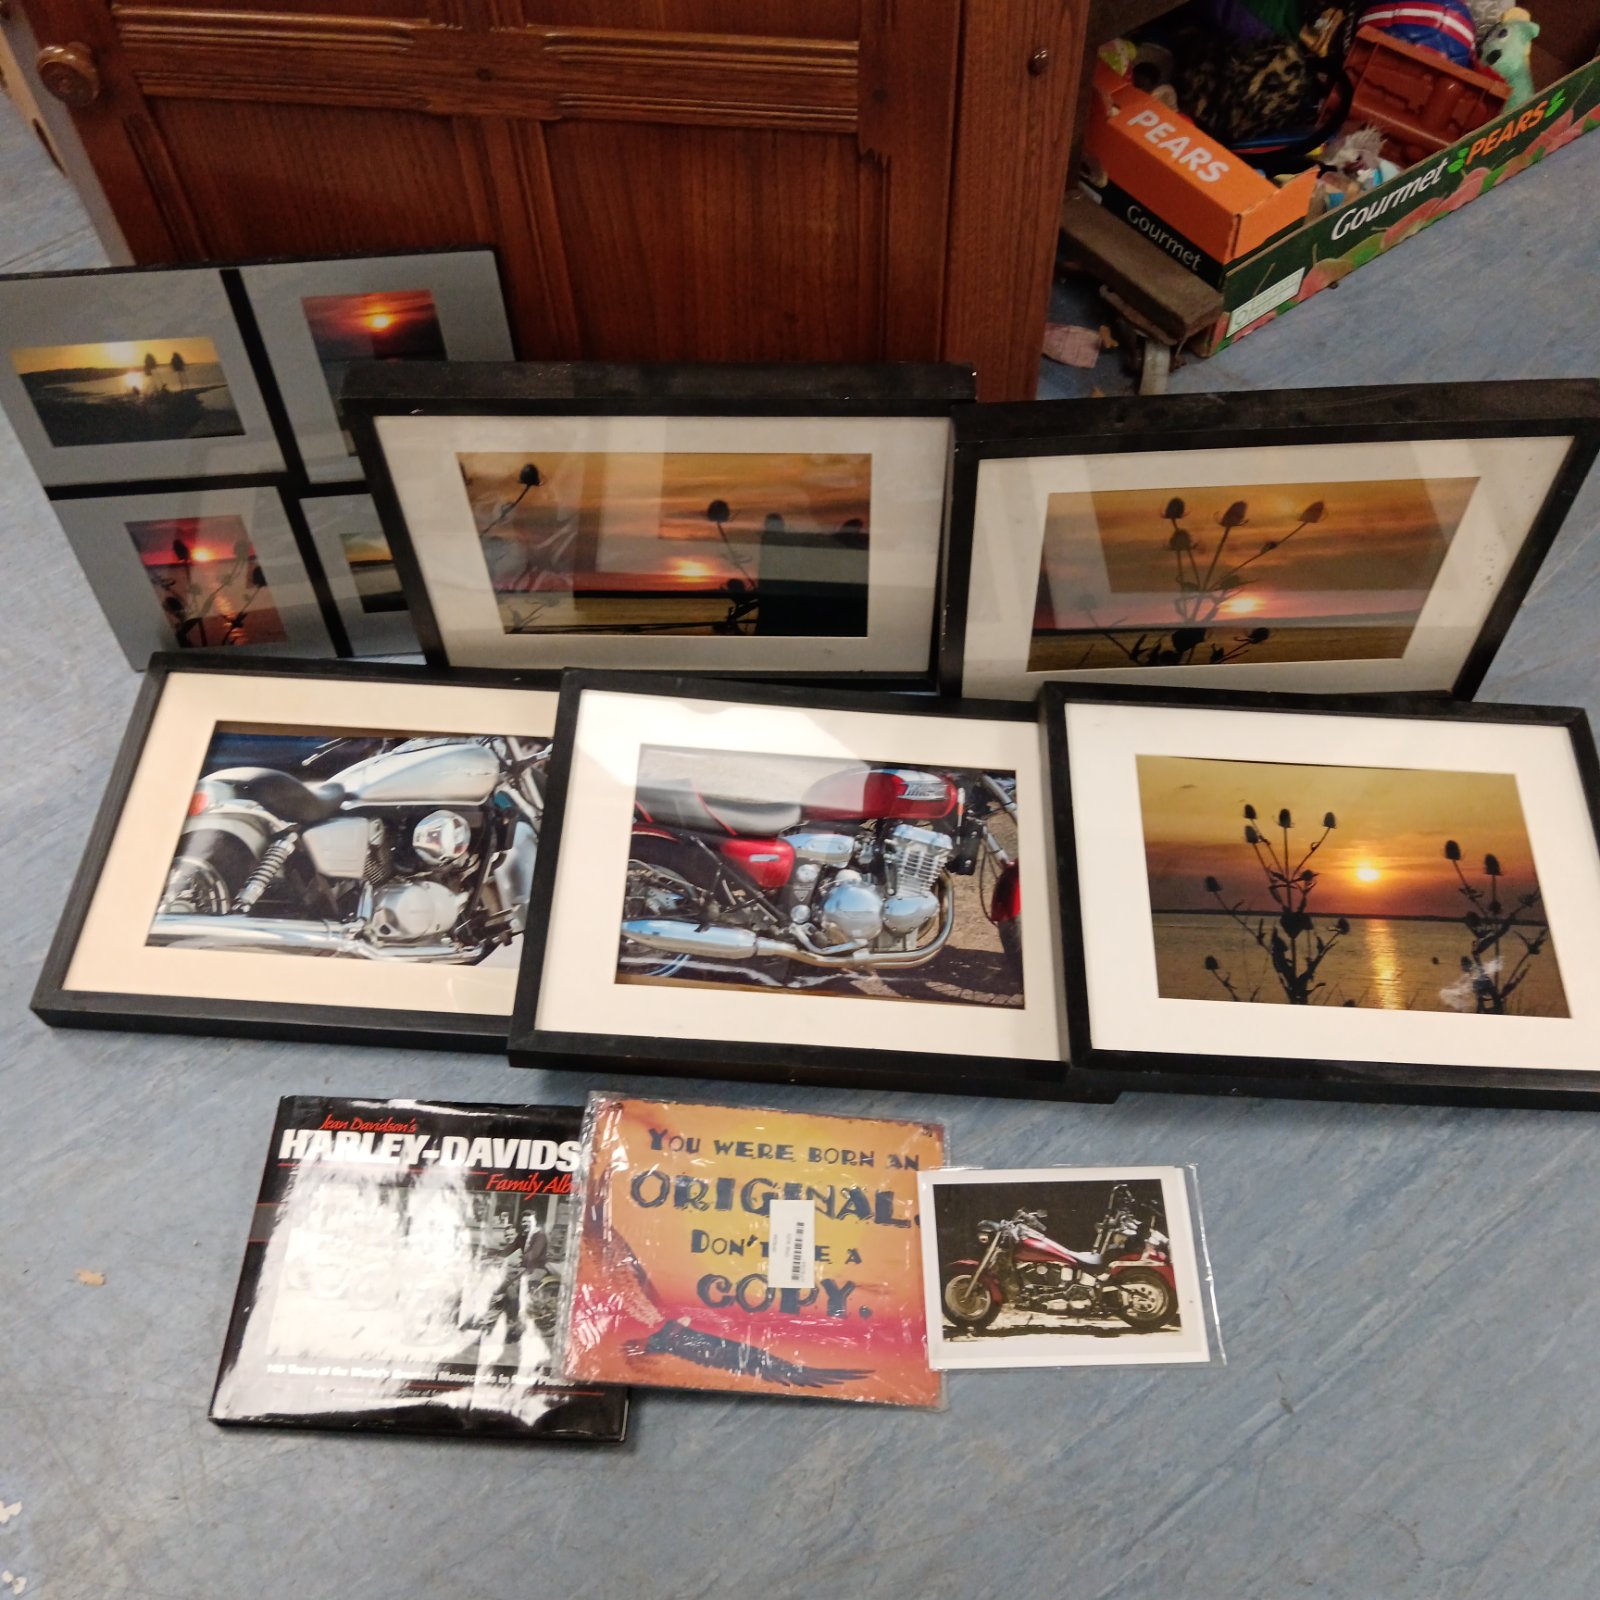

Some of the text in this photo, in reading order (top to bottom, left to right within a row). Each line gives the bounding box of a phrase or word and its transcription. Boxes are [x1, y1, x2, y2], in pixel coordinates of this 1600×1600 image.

[1127, 110, 1230, 183] PEARS
[1331, 100, 1548, 241] Gourmet PEARS
[1127, 205, 1202, 271] Gourmet
[319, 1114, 417, 1133] Jean Davidson's
[278, 1129, 582, 1172] HARLEY-DAVIDS
[808, 1146, 874, 1168] BORN
[486, 1171, 573, 1200] Family Alb
[697, 1273, 872, 1319] COPY.
